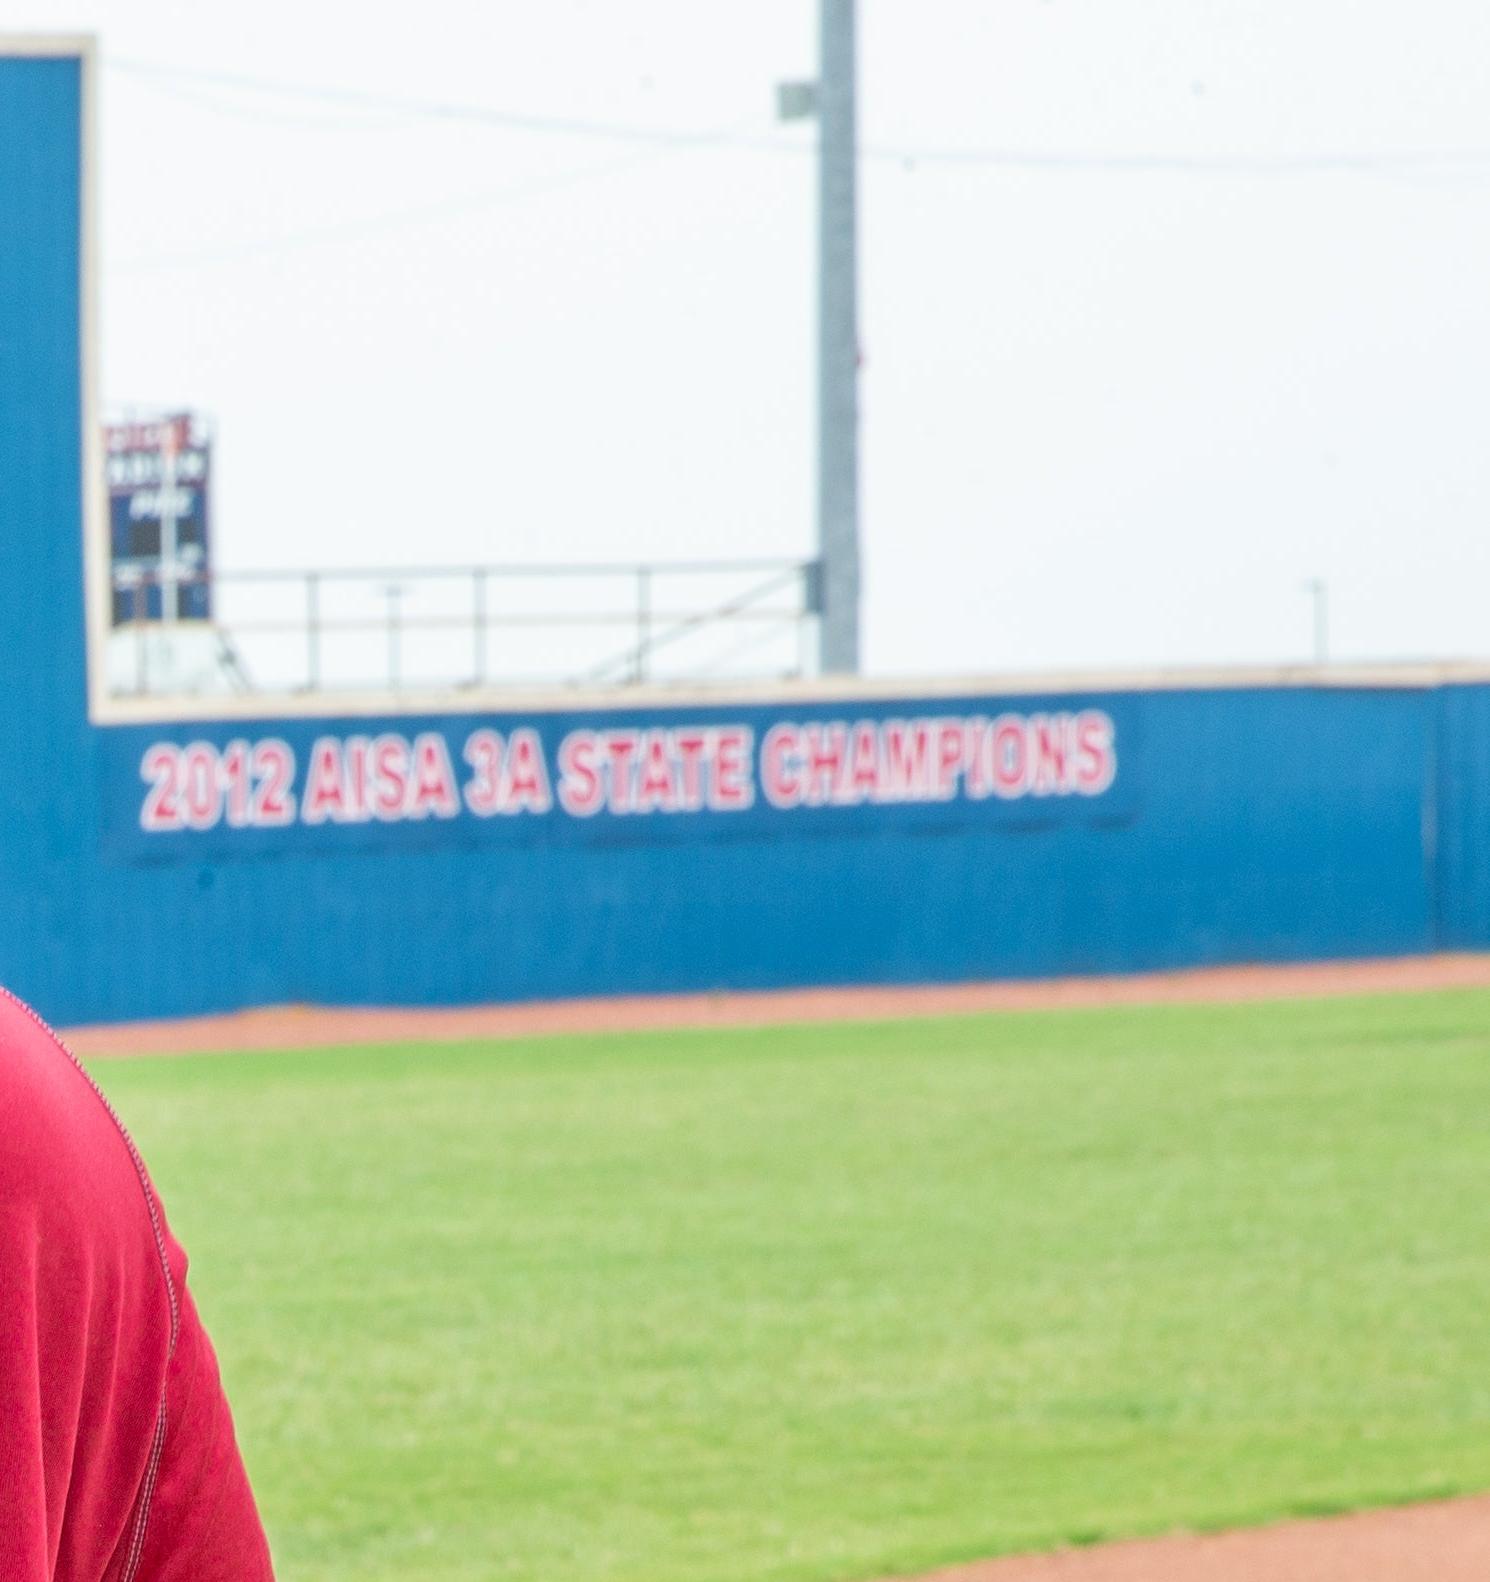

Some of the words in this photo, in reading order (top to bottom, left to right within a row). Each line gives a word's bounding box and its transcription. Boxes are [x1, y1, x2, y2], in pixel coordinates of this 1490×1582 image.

[140, 741, 297, 832] 2012
[301, 733, 462, 825] AISA
[463, 727, 553, 818] 3A
[558, 723, 755, 817] STATE
[760, 709, 1118, 809] CHAMPIONS
